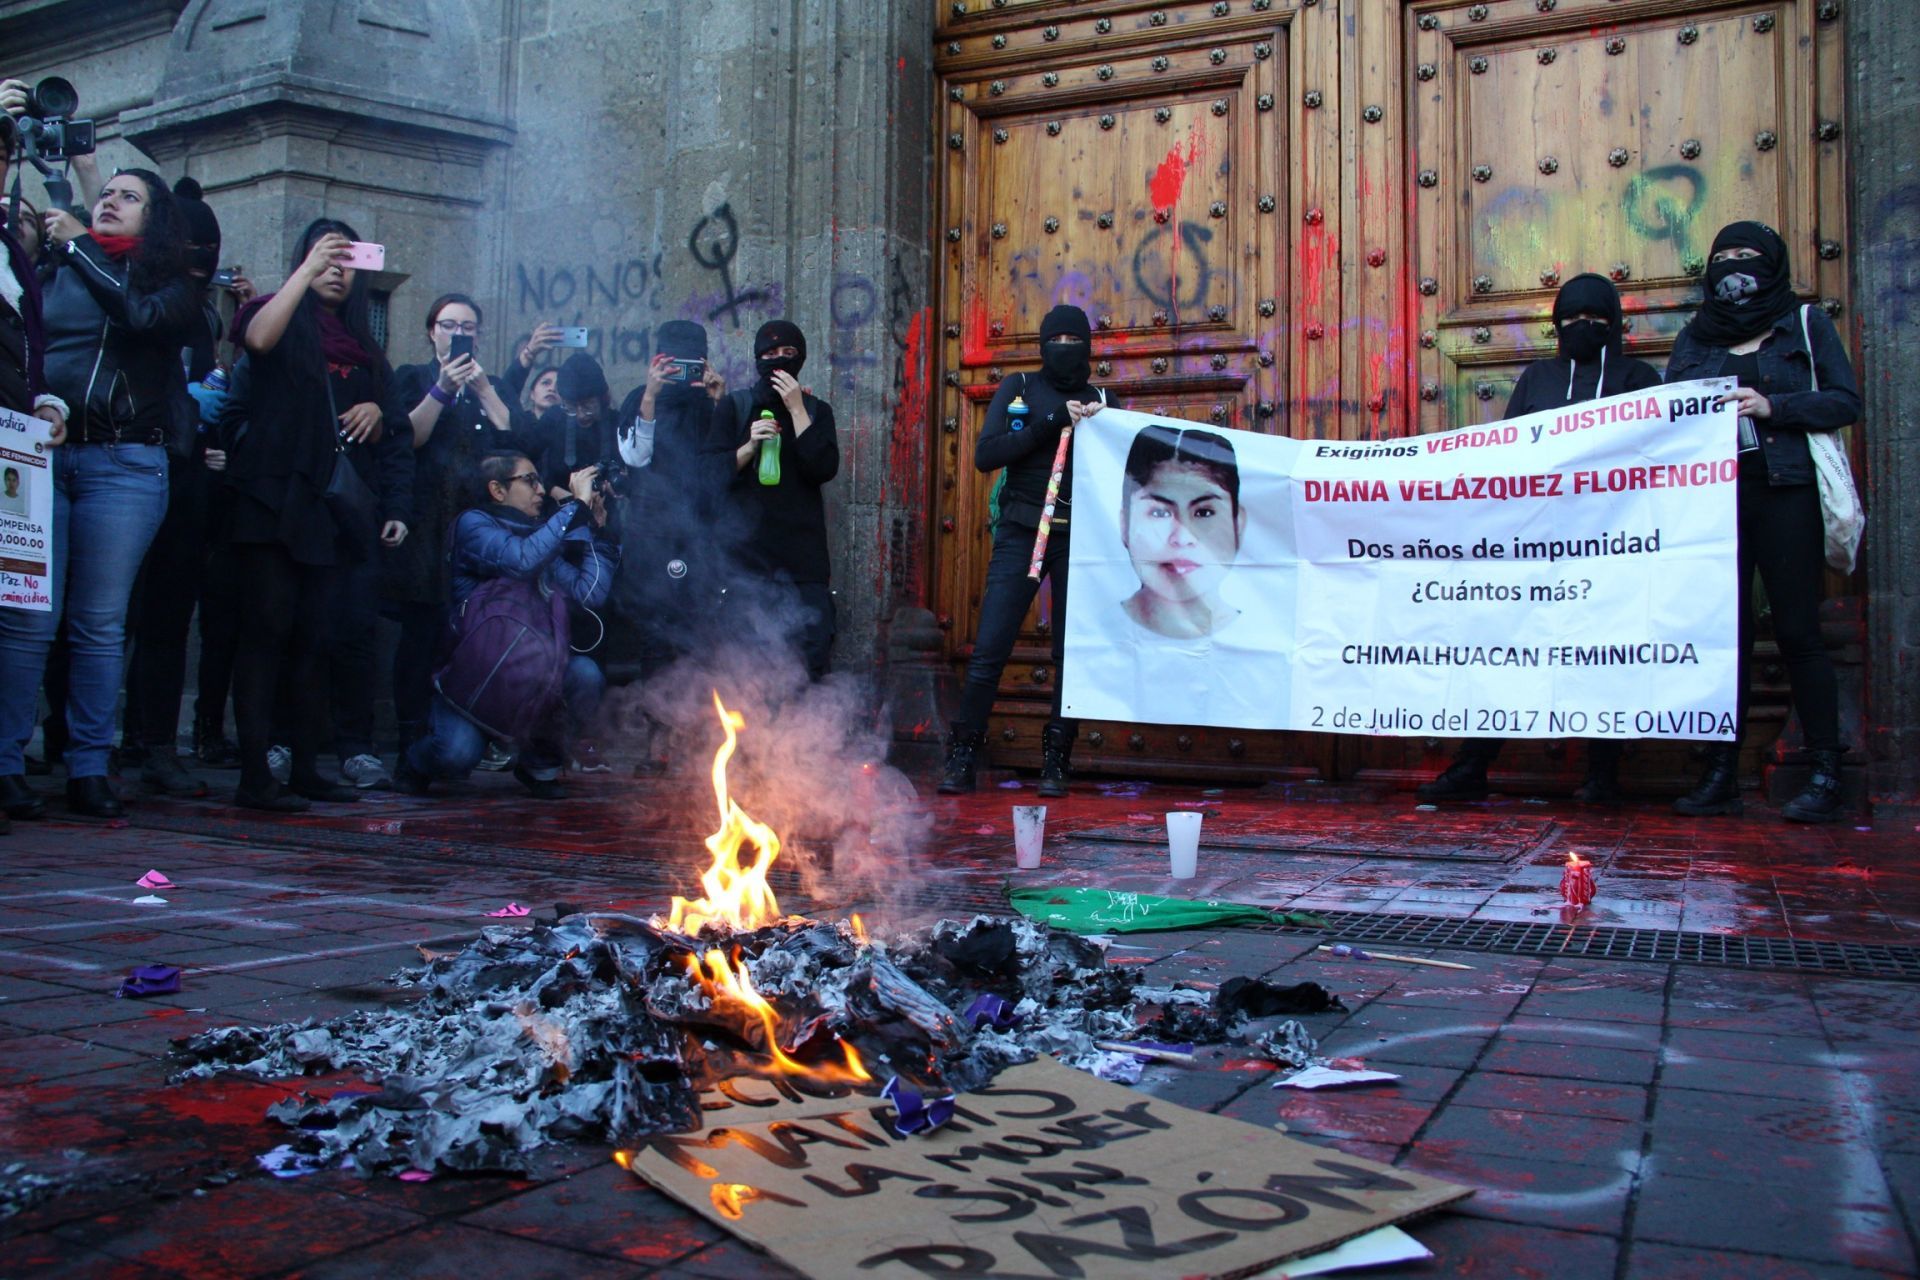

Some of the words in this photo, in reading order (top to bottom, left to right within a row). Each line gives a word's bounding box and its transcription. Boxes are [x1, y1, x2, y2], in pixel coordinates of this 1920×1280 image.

[1315, 444, 1419, 460] Exigimos
[1426, 426, 1519, 454] VERDAD
[1530, 424, 1544, 444] y
[1549, 397, 1662, 436] JUSTICIA
[1669, 393, 1726, 423] para
[1304, 480, 1390, 502] DIANA
[1399, 473, 1564, 502] VELÁZQUEZ
[1574, 459, 1737, 494] FLORENCIO
[1347, 539, 1394, 559] Dos
[1402, 538, 1464, 559] años
[1472, 538, 1505, 559] de
[1514, 528, 1660, 562] impunidad
[1411, 580, 1522, 603] ¿Cuántos
[1530, 579, 1593, 602] más?
[1341, 645, 1539, 667] CHIMALHUACAN
[1548, 643, 1699, 666] FEMINICIDA
[1311, 706, 1324, 727] 2
[1333, 706, 1362, 729] de
[1365, 707, 1424, 730] Julio
[1432, 708, 1468, 731] del
[1477, 709, 1539, 732] 2017
[1549, 711, 1588, 734] NO
[1597, 711, 1627, 734] SE
[1635, 710, 1737, 735] OLVIDA
[803, 1163, 936, 1199] LA
[914, 1161, 1151, 1223] SIN
